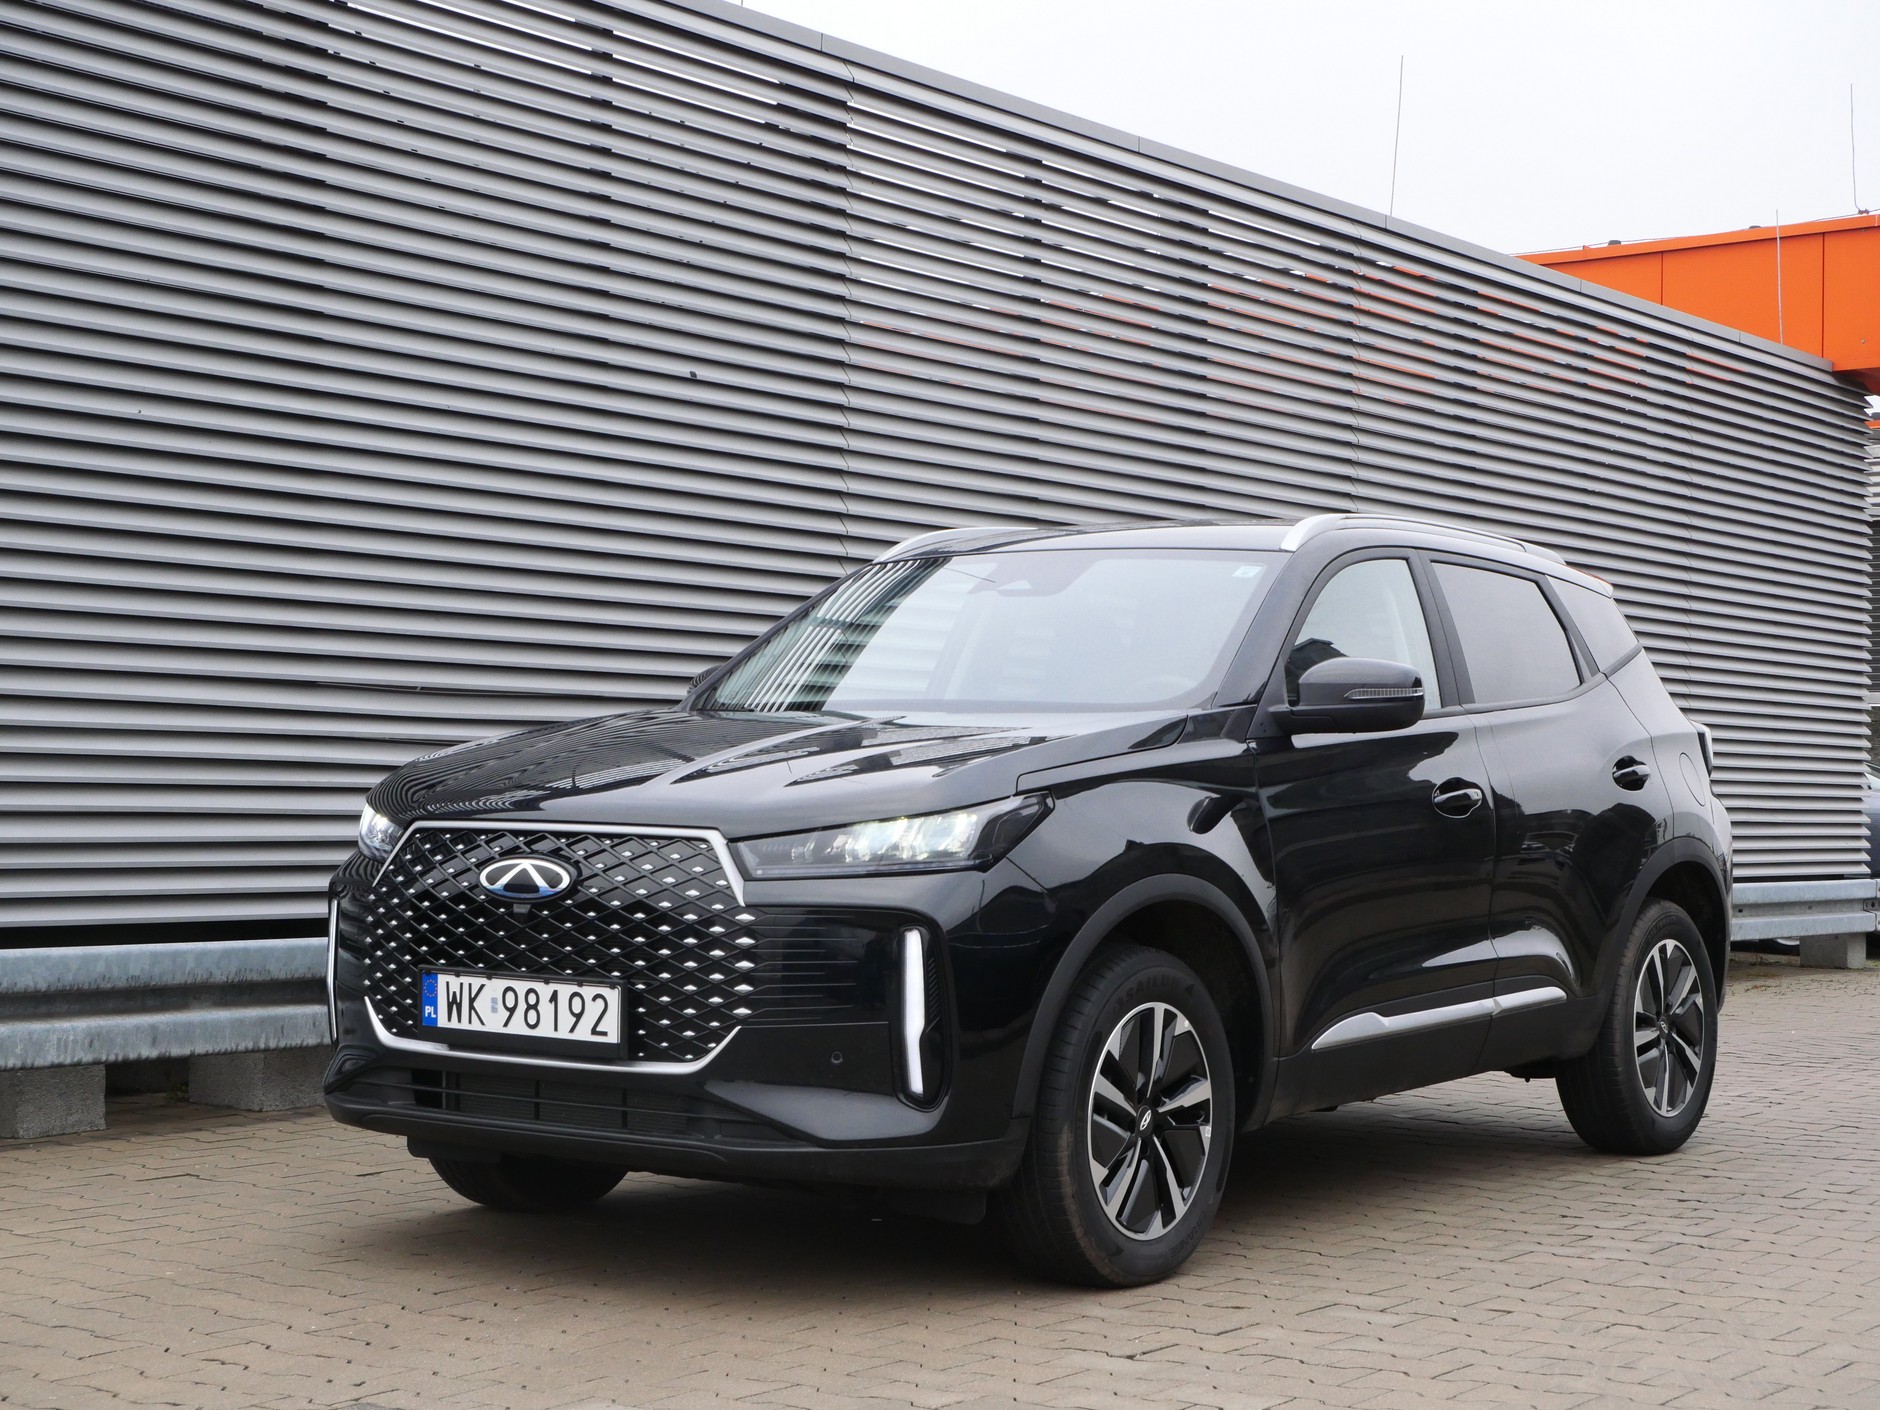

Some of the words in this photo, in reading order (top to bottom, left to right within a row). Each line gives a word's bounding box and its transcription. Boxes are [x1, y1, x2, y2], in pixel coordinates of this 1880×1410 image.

[425, 1005, 437, 1019] PL
[446, 981, 486, 1026] WK
[502, 986, 609, 1037] 98192
